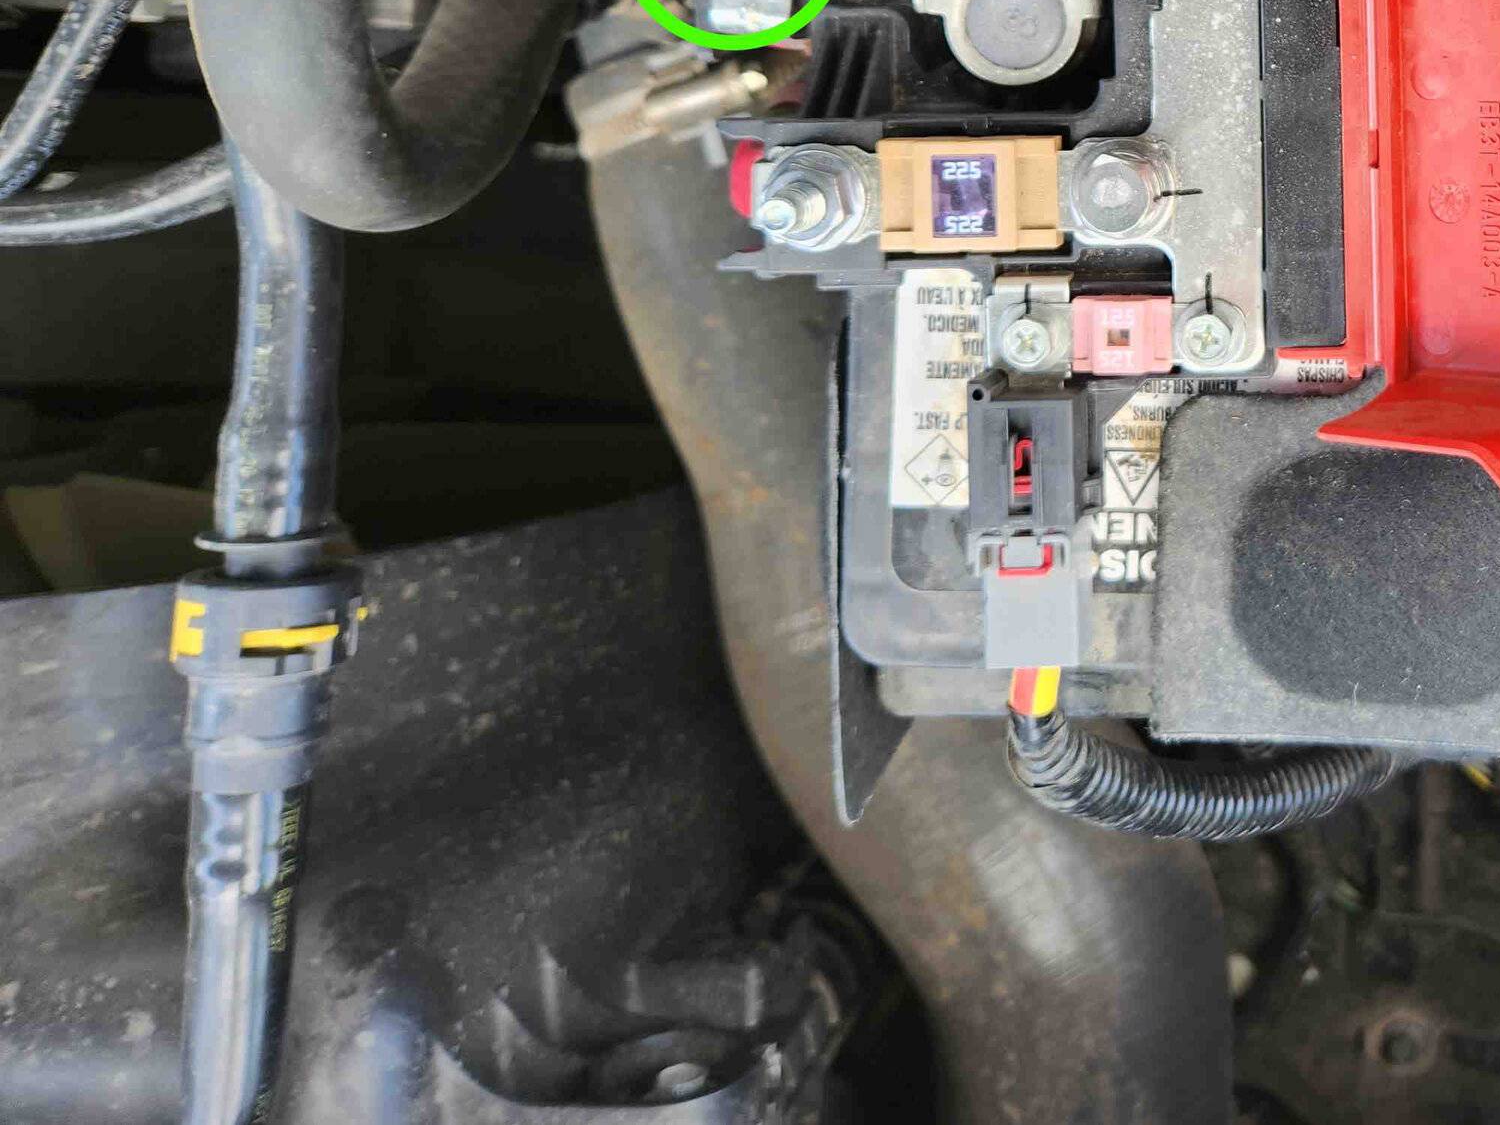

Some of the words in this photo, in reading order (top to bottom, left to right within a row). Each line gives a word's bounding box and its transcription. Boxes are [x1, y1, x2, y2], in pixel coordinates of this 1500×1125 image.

[941, 161, 982, 180] 225
[943, 215, 984, 233] 225
[1101, 308, 1136, 325] 125
[1101, 351, 1136, 369] 125
[1297, 367, 1345, 383] CHISPAS
[914, 412, 950, 430] FAST.
